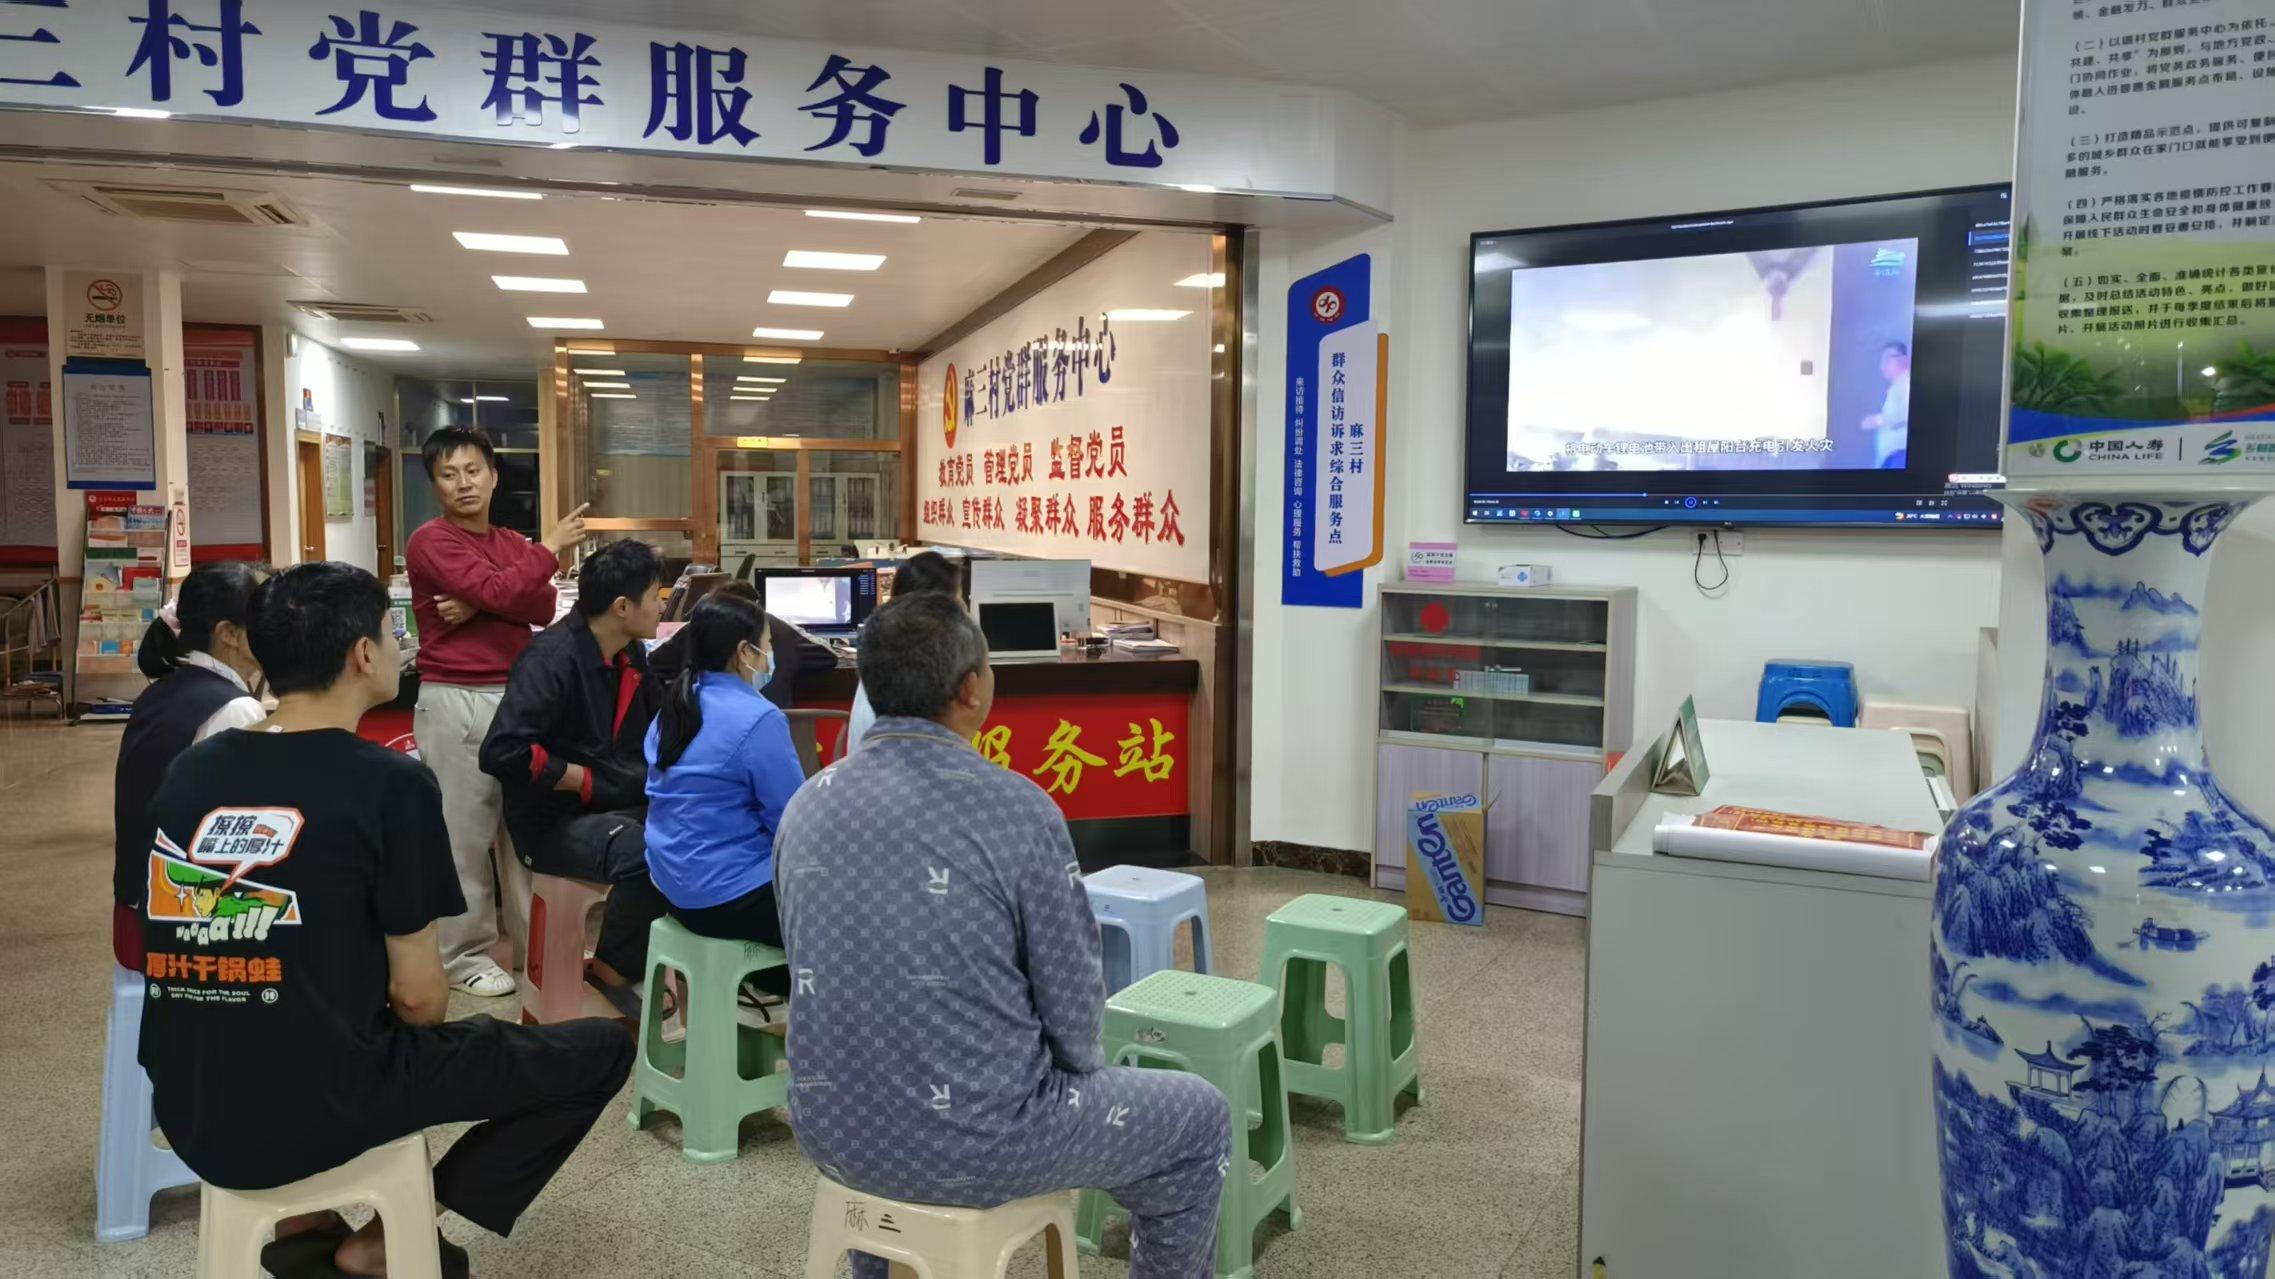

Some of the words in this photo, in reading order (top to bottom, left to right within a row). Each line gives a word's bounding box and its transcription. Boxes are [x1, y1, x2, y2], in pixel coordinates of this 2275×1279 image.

[0, 0, 1179, 168] 三村党群服务中心
[964, 312, 1117, 428] 麻三村党群服务中心
[938, 453, 975, 487] 教育党员
[983, 443, 1034, 486] 管理党员
[1048, 425, 1128, 481] 监督党员
[1328, 352, 1346, 544] 群众信访诉求综合服务点
[1349, 423, 1364, 474] 麻三村
[2088, 438, 2164, 452] 中国人寿
[2088, 452, 2130, 461] CHINA
[2134, 453, 2163, 461] LIFE
[922, 497, 955, 527] 组织群众
[962, 496, 1006, 531] 宣传群众
[1015, 492, 1080, 537] 凝聚群众
[1087, 489, 1185, 546] 服务群众
[207, 815, 257, 837] 擦擦
[146, 952, 282, 982] 厚汁干锅蛙
